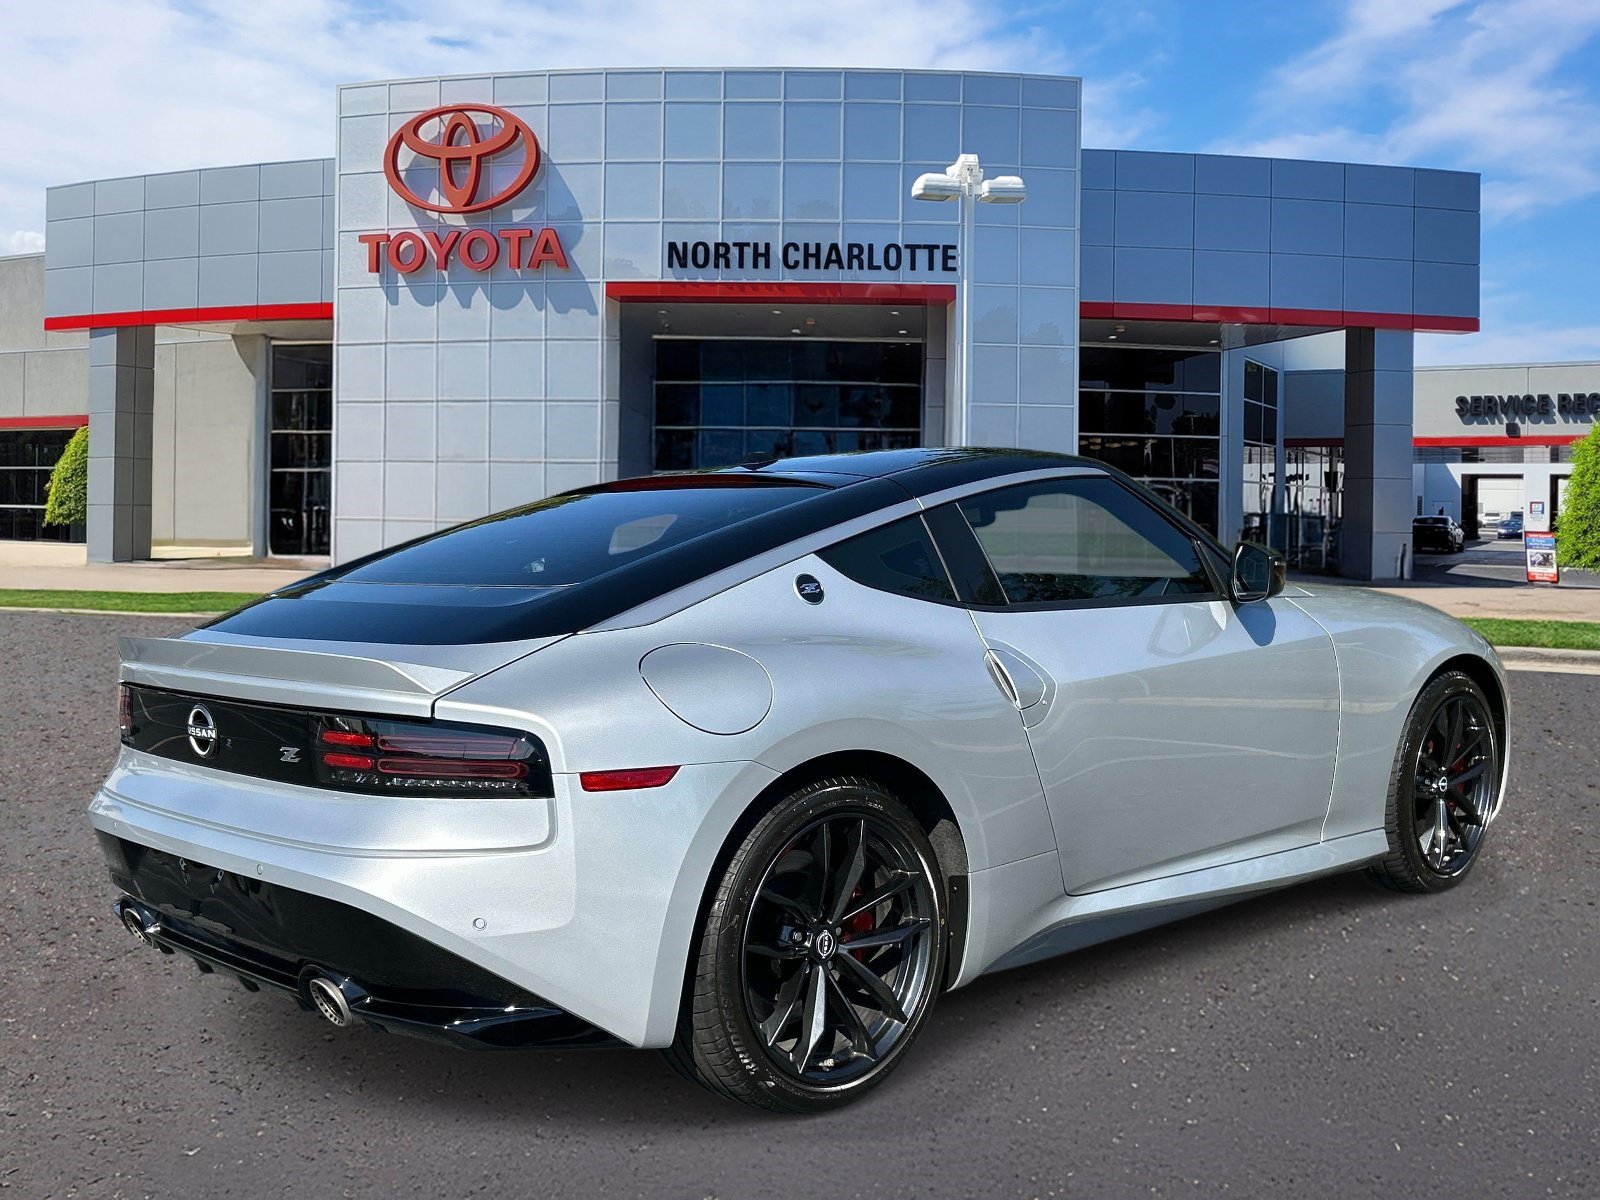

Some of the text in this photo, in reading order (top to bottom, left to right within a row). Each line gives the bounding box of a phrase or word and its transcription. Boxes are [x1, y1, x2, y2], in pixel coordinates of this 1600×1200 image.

[359, 228, 569, 273] TOYOTA
[667, 241, 958, 272] NORTH CHARLOTTE
[1455, 394, 1551, 417] SERVICE
[279, 746, 301, 763] Z
